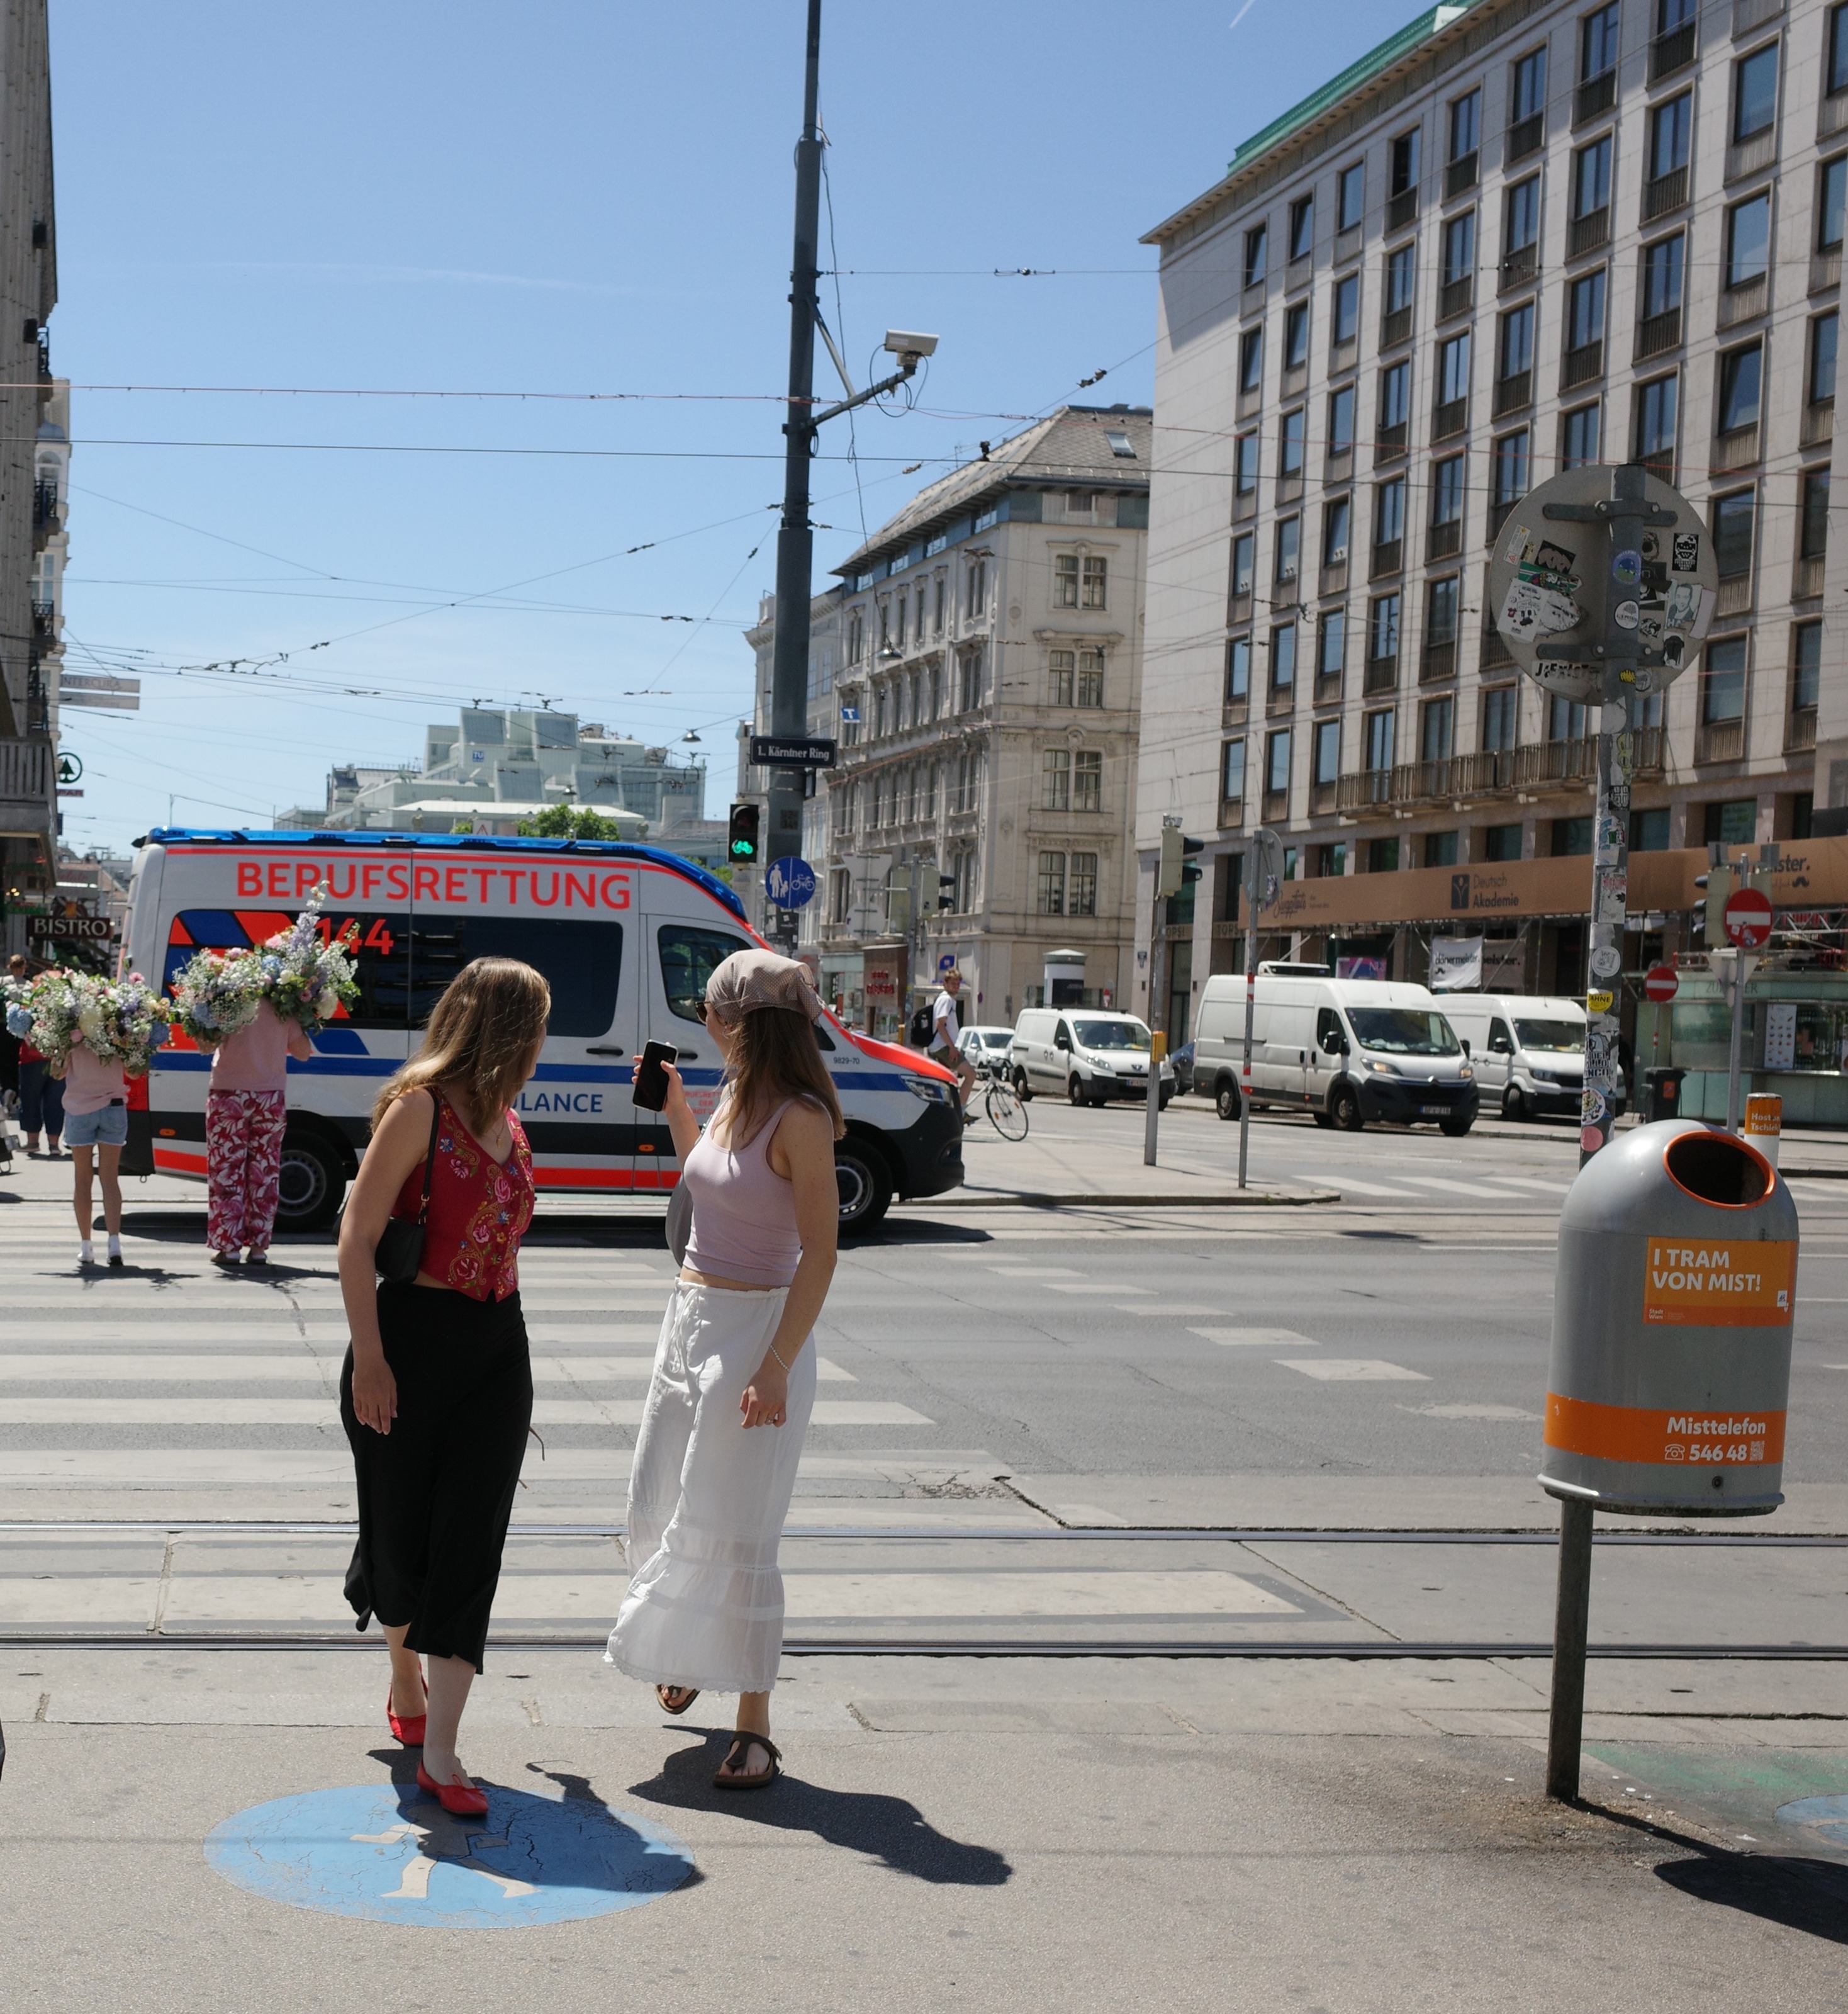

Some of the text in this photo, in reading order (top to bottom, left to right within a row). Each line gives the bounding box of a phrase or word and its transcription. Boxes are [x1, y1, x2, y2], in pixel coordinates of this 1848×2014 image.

[768, 745, 807, 758] Kärntner
[809, 747, 829, 762] Ring
[237, 862, 630, 910] BERUFSRETTUNG
[1474, 874, 1507, 889] Deutsch
[1472, 891, 1519, 908] Akademie
[34, 918, 107, 936] BISTRO
[316, 917, 394, 955] 144
[1483, 954, 1521, 965] eister.
[1654, 1248, 1730, 1268] I TRAM
[1652, 1271, 1761, 1291] VON MIST!
[1667, 1416, 1766, 1435] Misttelefon
[1689, 1444, 1747, 1461] 546 48
